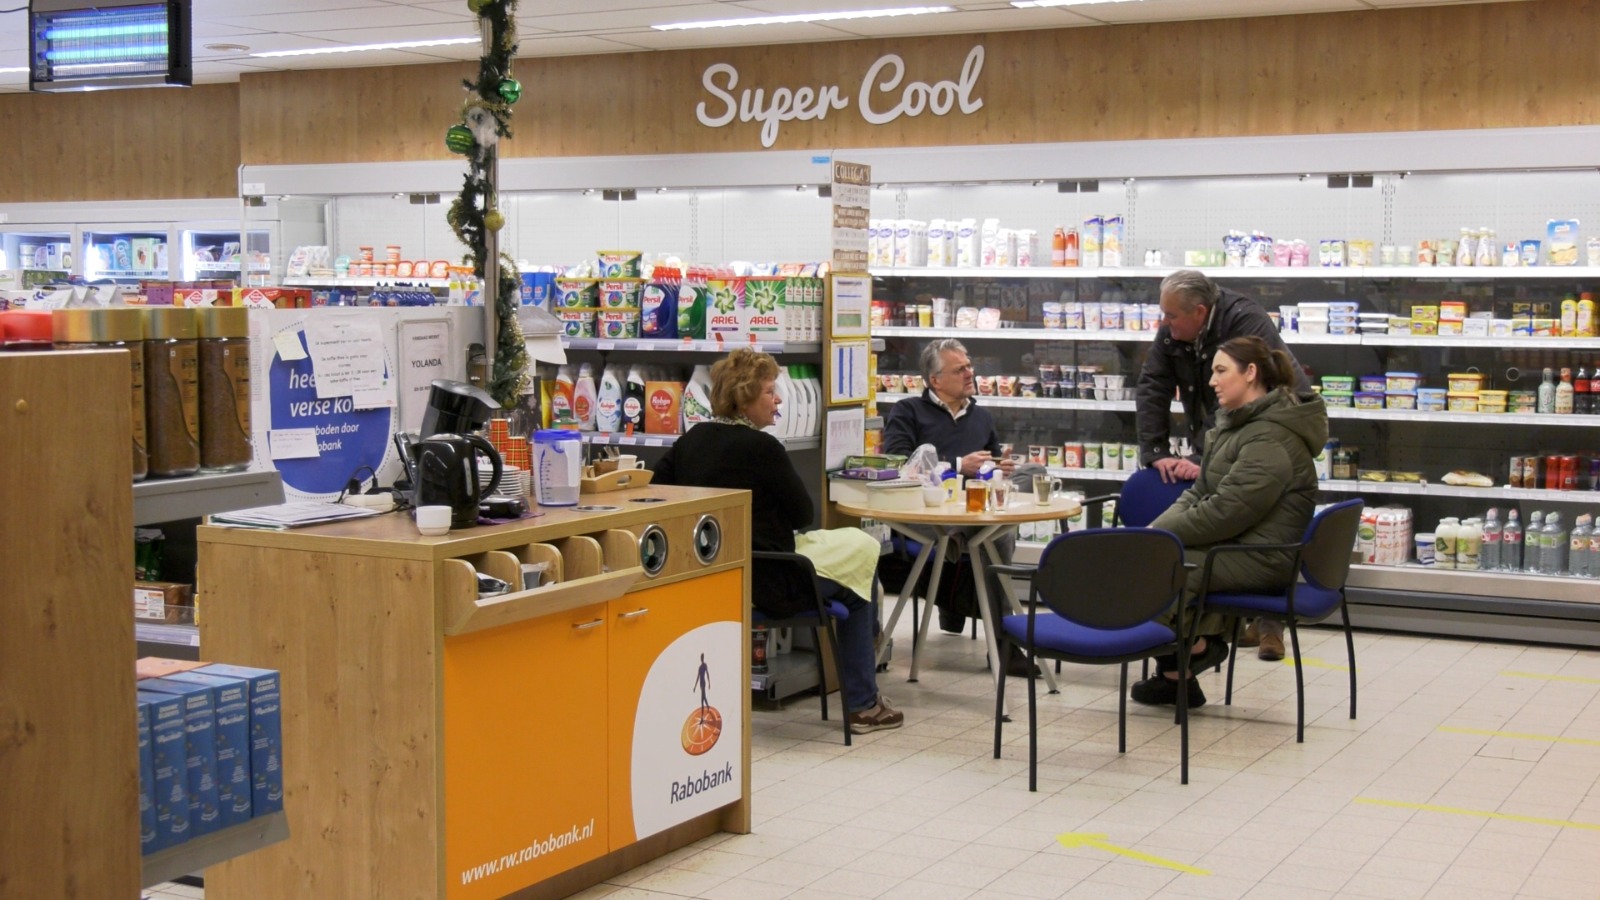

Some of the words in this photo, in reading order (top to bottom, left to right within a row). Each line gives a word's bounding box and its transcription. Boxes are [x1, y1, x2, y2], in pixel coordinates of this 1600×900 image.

[696, 63, 849, 148] Super
[859, 45, 985, 125] Cool
[606, 282, 624, 290] Persil
[563, 312, 581, 320] Persil
[605, 312, 624, 320] Persil
[711, 316, 740, 325] ARIEL
[750, 316, 779, 325] ARIEL
[411, 358, 442, 368] YOLANDA
[290, 397, 330, 418] verse
[315, 423, 339, 435] boden
[341, 423, 360, 433] door
[670, 761, 733, 804] Rabobank
[461, 818, 594, 885] www.rw.rabobank.nl
